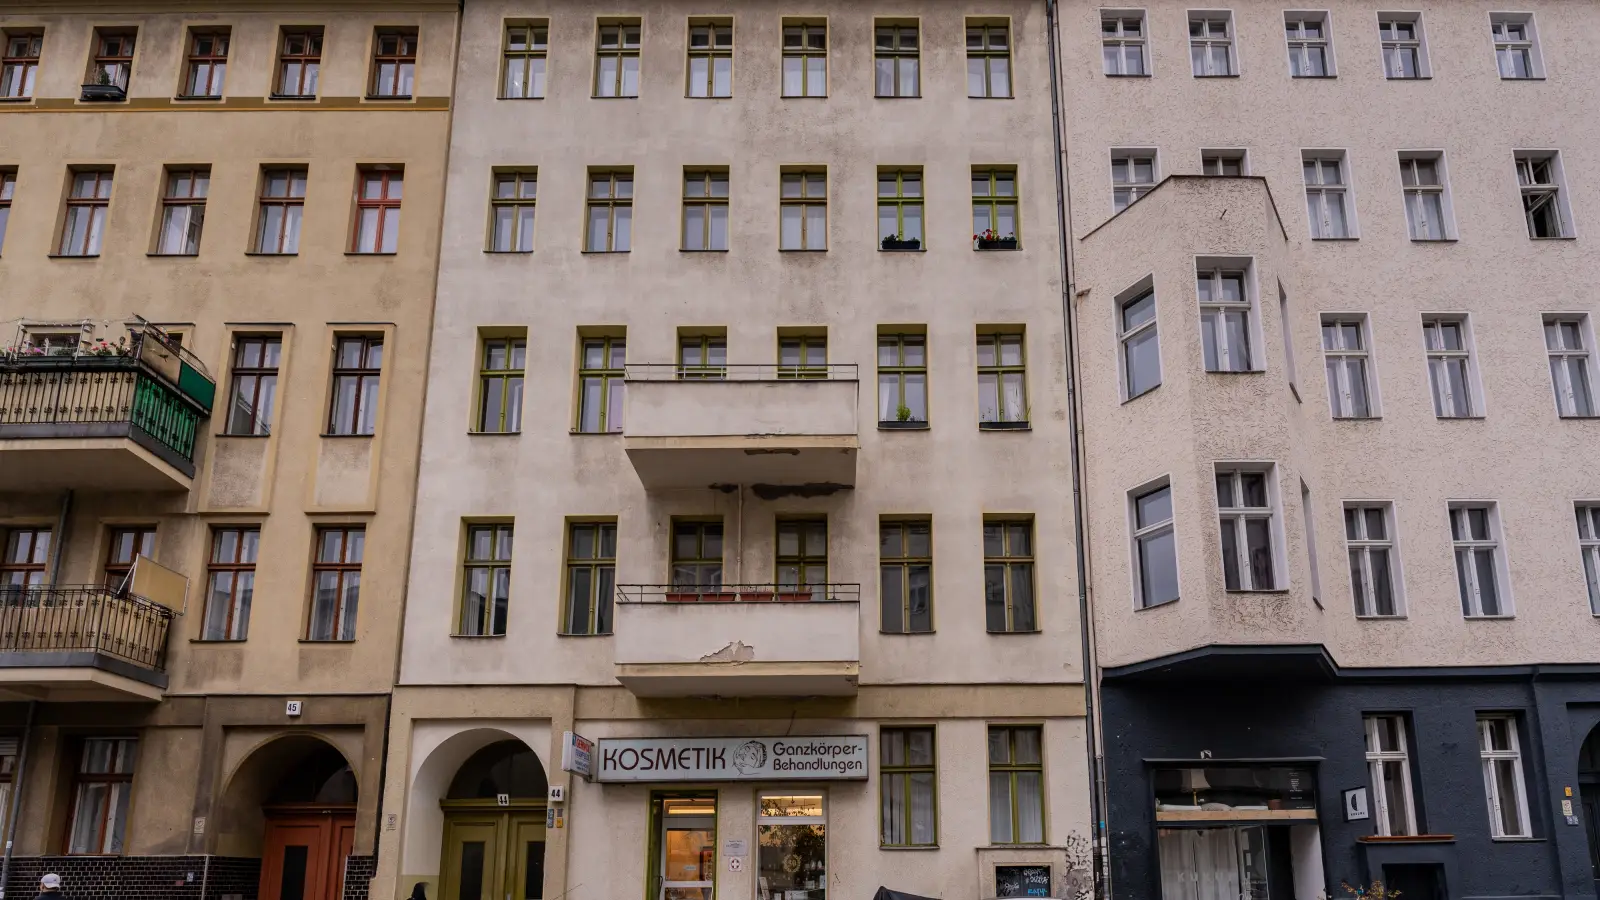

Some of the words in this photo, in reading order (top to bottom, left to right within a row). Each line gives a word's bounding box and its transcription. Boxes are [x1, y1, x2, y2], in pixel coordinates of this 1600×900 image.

[287, 703, 297, 712] 45
[772, 742, 863, 758] Ganzkörper-
[603, 747, 727, 771] KOSMETIK
[773, 758, 863, 774] Behandlungen
[551, 788, 561, 798] 44
[499, 795, 508, 805] 44
